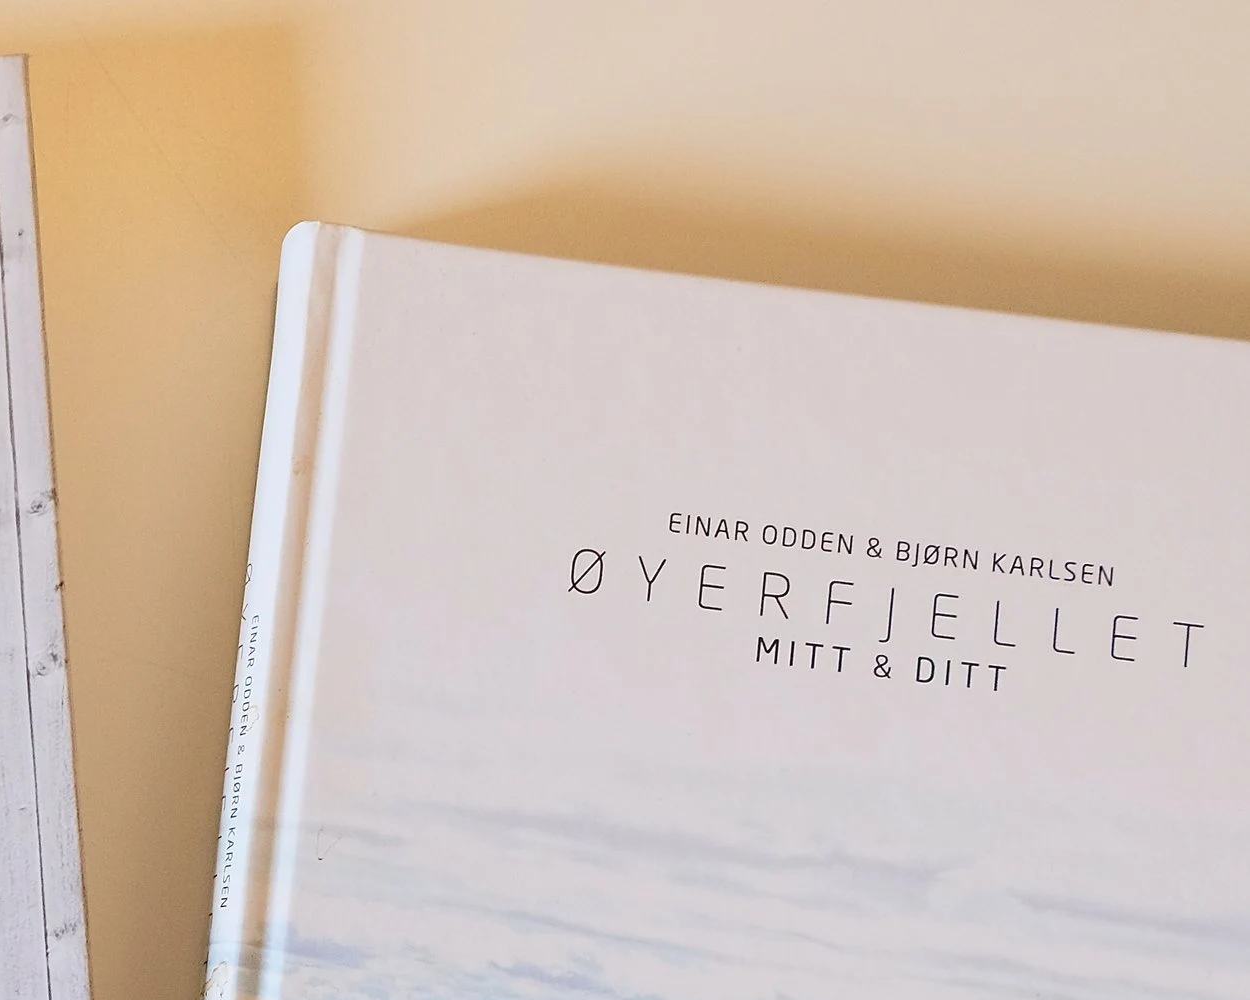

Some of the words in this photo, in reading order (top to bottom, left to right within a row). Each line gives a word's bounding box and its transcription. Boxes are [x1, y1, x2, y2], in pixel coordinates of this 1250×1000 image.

[668, 512, 749, 542] EINAR
[762, 524, 854, 555] ODDEN
[866, 537, 882, 559] &
[895, 540, 979, 570] BJØRN
[992, 552, 1114, 587] KARLSEN
[567, 548, 1205, 668] ØYERFJELLET
[246, 614, 260, 668] EINAR
[755, 636, 851, 673] MITT
[873, 654, 892, 679] &
[915, 656, 1007, 692] DITT
[239, 676, 253, 737] ODDEN
[237, 744, 246, 756] &
[220, 827, 236, 909] KARLSEN
